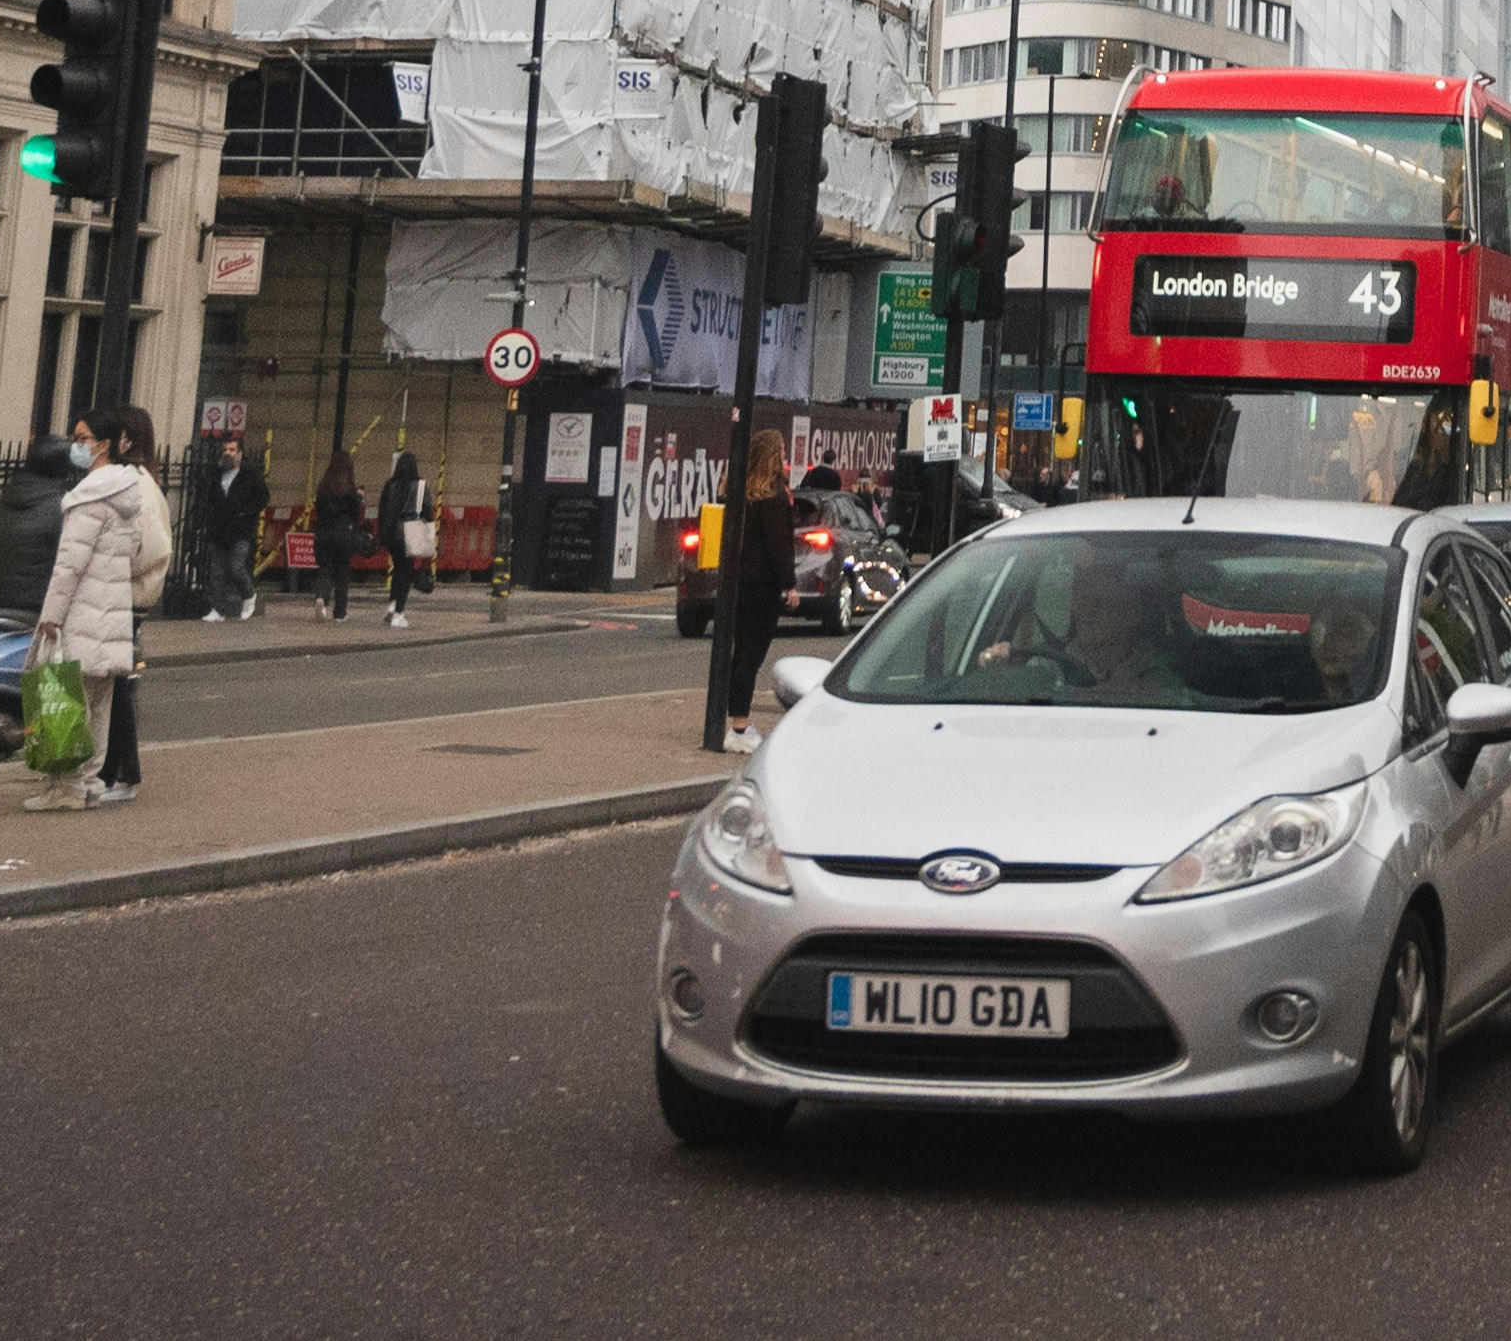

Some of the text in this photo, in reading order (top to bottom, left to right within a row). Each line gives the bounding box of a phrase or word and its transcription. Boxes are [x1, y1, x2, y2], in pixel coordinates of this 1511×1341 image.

[396, 74, 423, 93] SIS
[618, 71, 652, 90] SIS
[931, 171, 958, 185] SIS
[896, 276, 933, 287] Ring roa
[1153, 271, 1402, 315] London Bridge 43
[893, 311, 916, 320] West
[893, 321, 948, 332] Westminster
[891, 331, 932, 341] Islington
[493, 346, 533, 368] 30
[883, 361, 926, 371] Highbury
[1383, 365, 1440, 380] BDE2639
[882, 371, 915, 379] A1200
[937, 860, 982, 882] Ford
[865, 981, 1052, 1028] WL10 GDA
